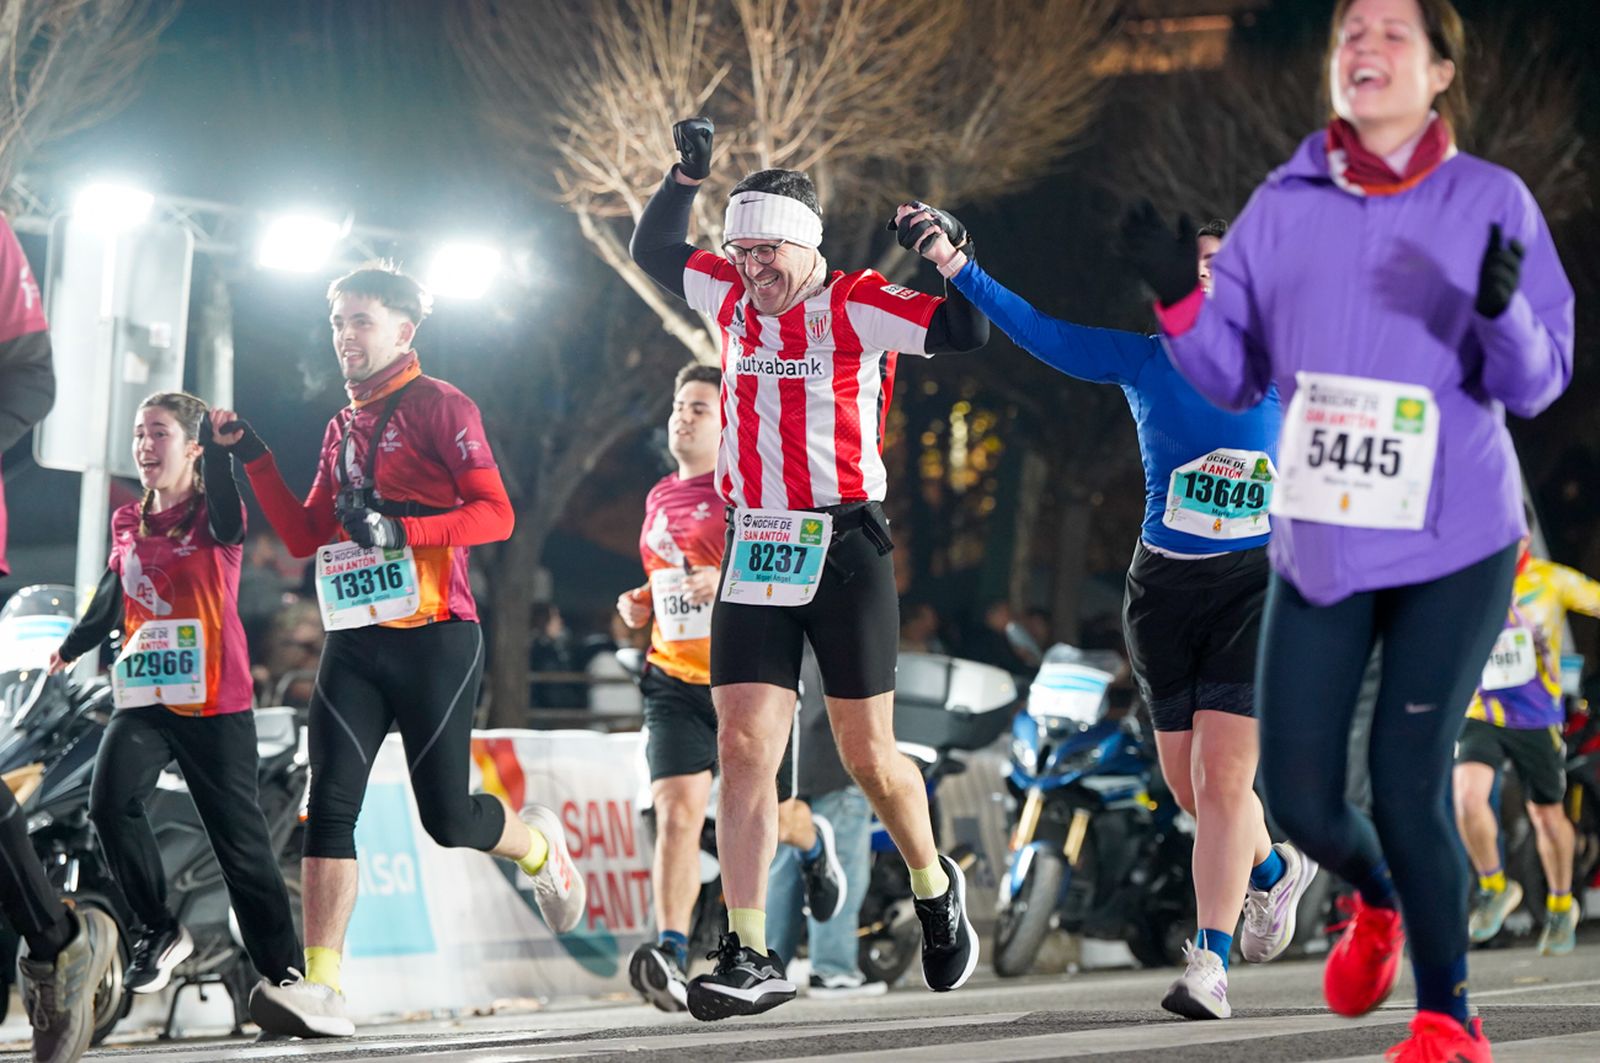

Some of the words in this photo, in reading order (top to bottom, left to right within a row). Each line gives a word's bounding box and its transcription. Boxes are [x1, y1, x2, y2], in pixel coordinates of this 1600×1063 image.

[1308, 428, 1403, 478] 5445
[1207, 464, 1244, 479] ANTÓN
[1183, 472, 1265, 509] 13649
[743, 530, 758, 541] SAN
[758, 530, 791, 542] ANTÓN
[751, 519, 778, 530] NOCHE
[779, 520, 793, 531] DE
[325, 564, 344, 575] SAN
[345, 556, 377, 572] ANTÓN
[334, 549, 361, 561] NOCHE
[748, 543, 808, 574] 8237
[330, 562, 404, 600] 13316
[123, 650, 193, 678] 12966
[561, 799, 636, 860] SAN
[360, 848, 417, 897] lsa
[586, 869, 652, 931] ANT
